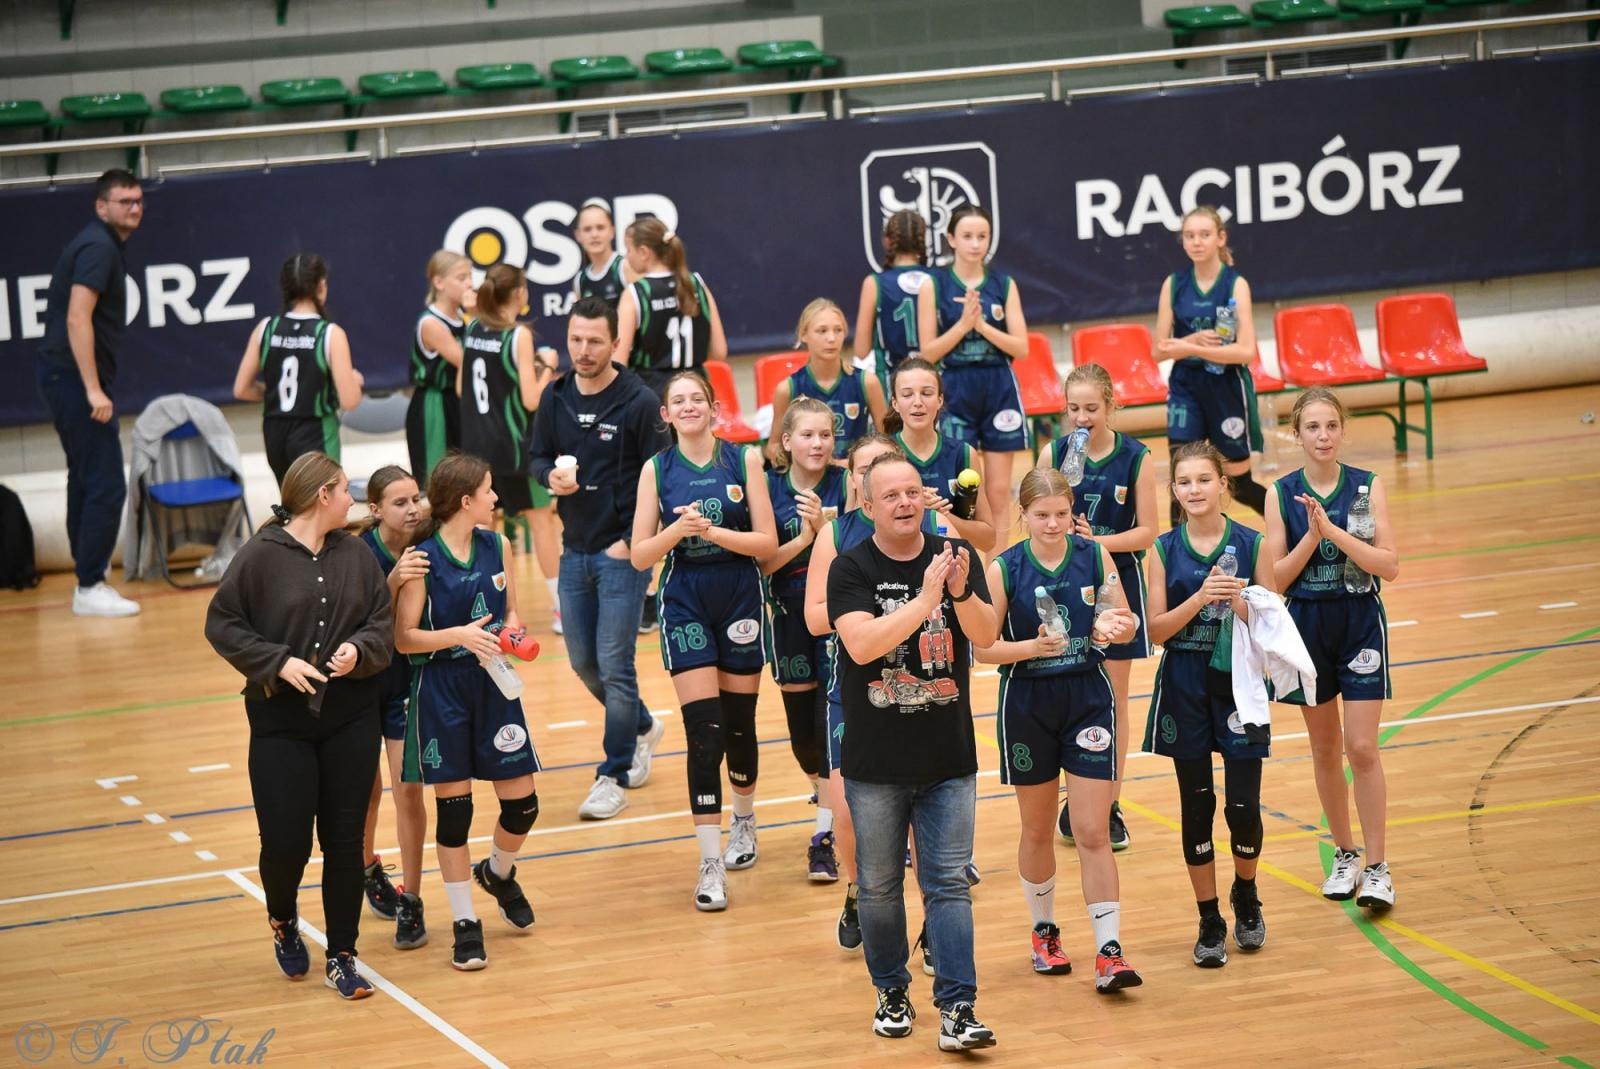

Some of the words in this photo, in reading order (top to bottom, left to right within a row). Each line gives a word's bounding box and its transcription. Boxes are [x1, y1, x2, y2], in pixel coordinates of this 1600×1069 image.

[1075, 135, 1464, 241] RACIBÓRZ
[666, 315, 694, 368] 11
[278, 355, 299, 412] 8
[472, 357, 489, 415] 6
[1083, 493, 1102, 521] 7
[784, 517, 804, 538] 1
[470, 592, 490, 619] 4
[671, 622, 708, 653] 18
[779, 654, 811, 680] 16
[1160, 714, 1177, 744] 9
[422, 738, 442, 769] 4
[1011, 742, 1033, 772] 8
[703, 794, 716, 806] NBA
